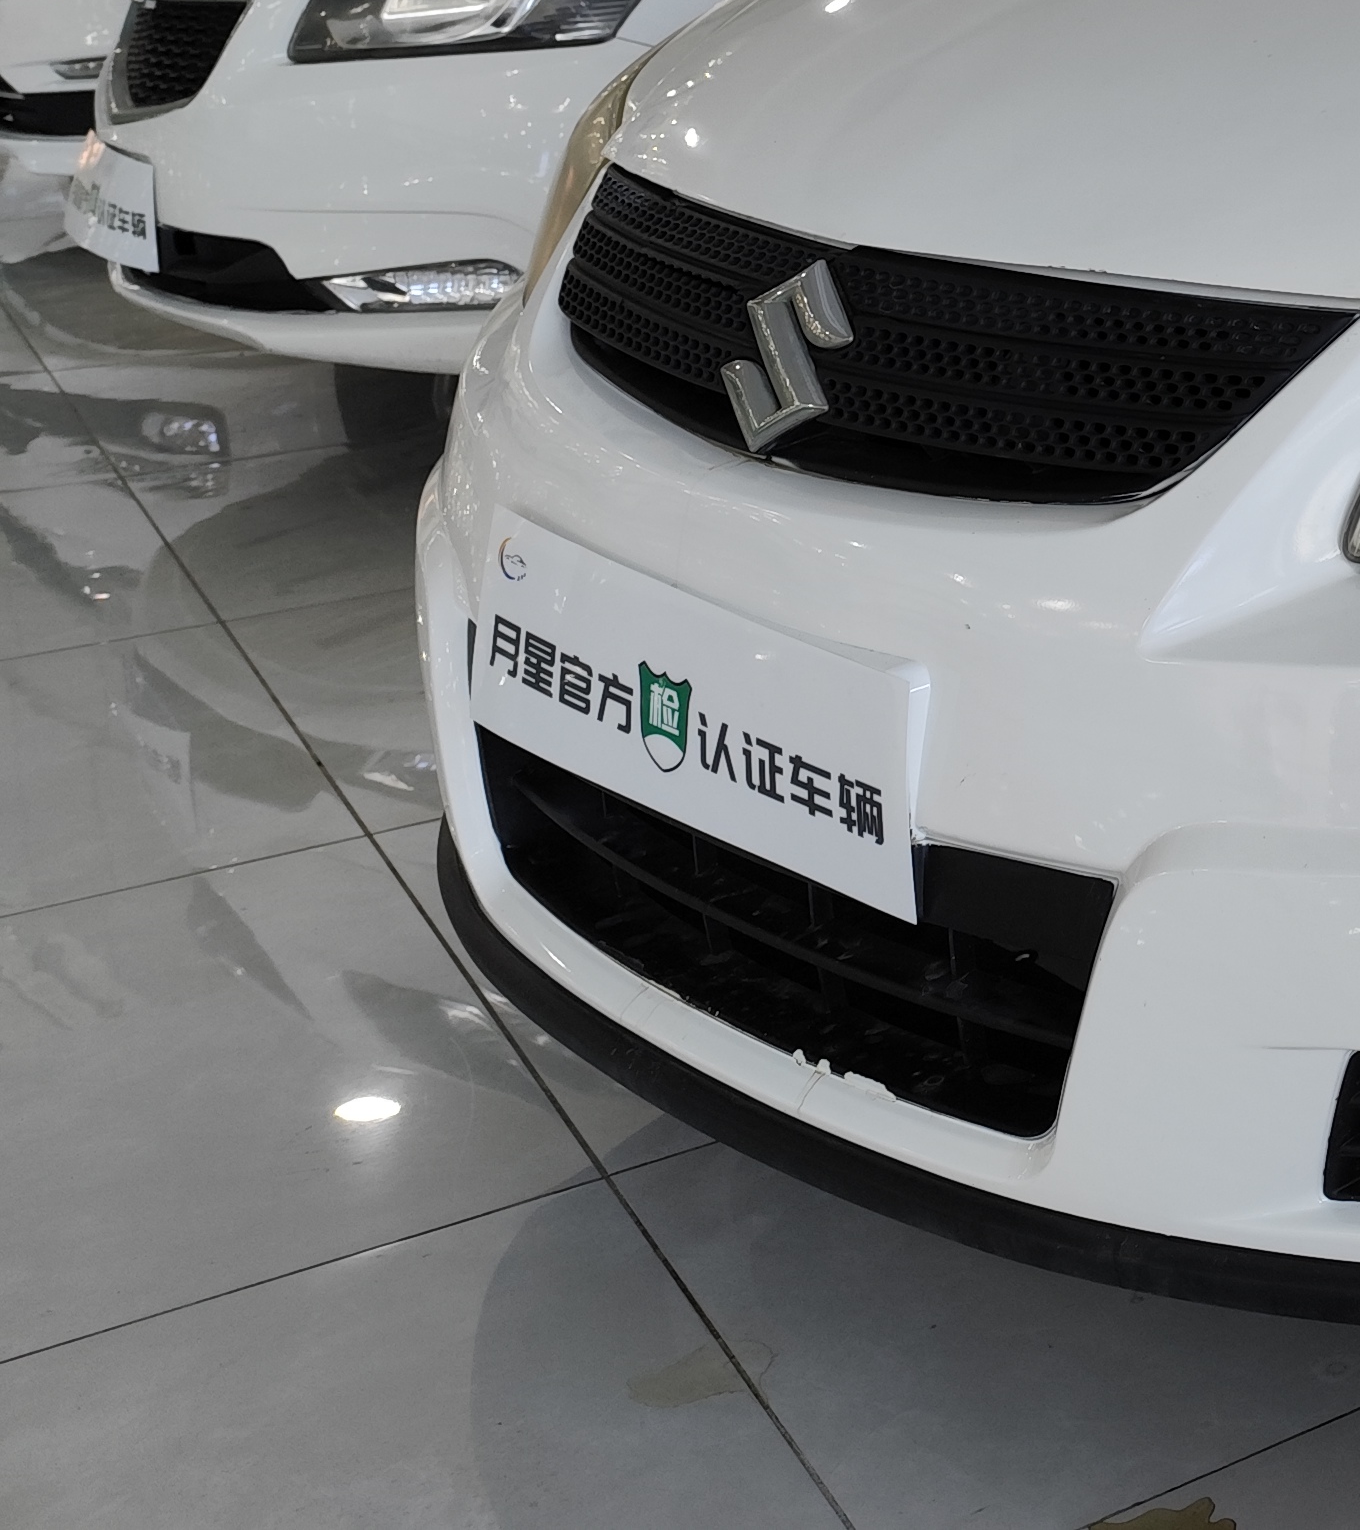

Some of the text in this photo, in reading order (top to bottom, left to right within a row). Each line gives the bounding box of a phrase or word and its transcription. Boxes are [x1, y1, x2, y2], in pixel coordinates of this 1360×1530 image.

[488, 613, 885, 846] 月星官方 检 认证车辆
